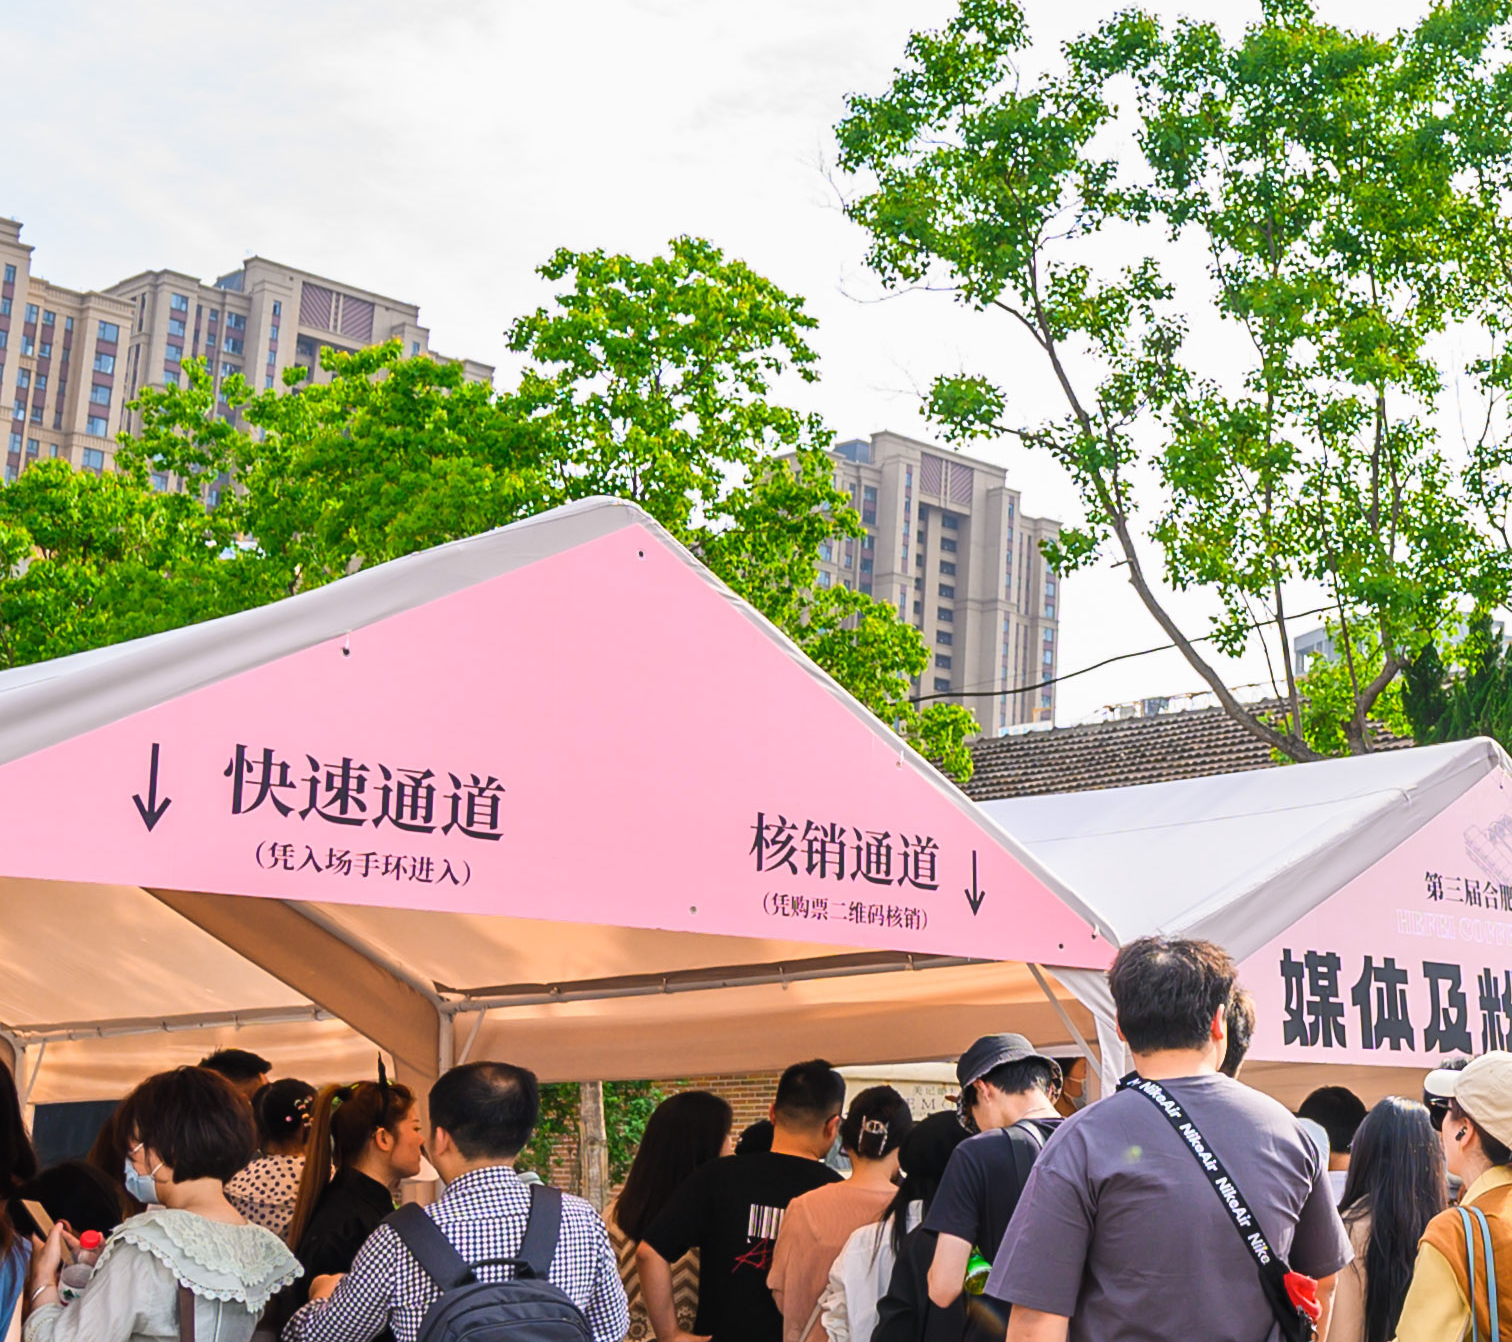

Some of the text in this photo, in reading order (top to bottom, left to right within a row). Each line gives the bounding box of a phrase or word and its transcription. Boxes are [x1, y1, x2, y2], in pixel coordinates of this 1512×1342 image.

[223, 743, 506, 842] 快速通道
[747, 811, 941, 893] 核销通道
[1395, 908, 1456, 940] HEFEI
[1139, 1080, 1271, 1266] NikeAir NikeAir NikeAir Nike
